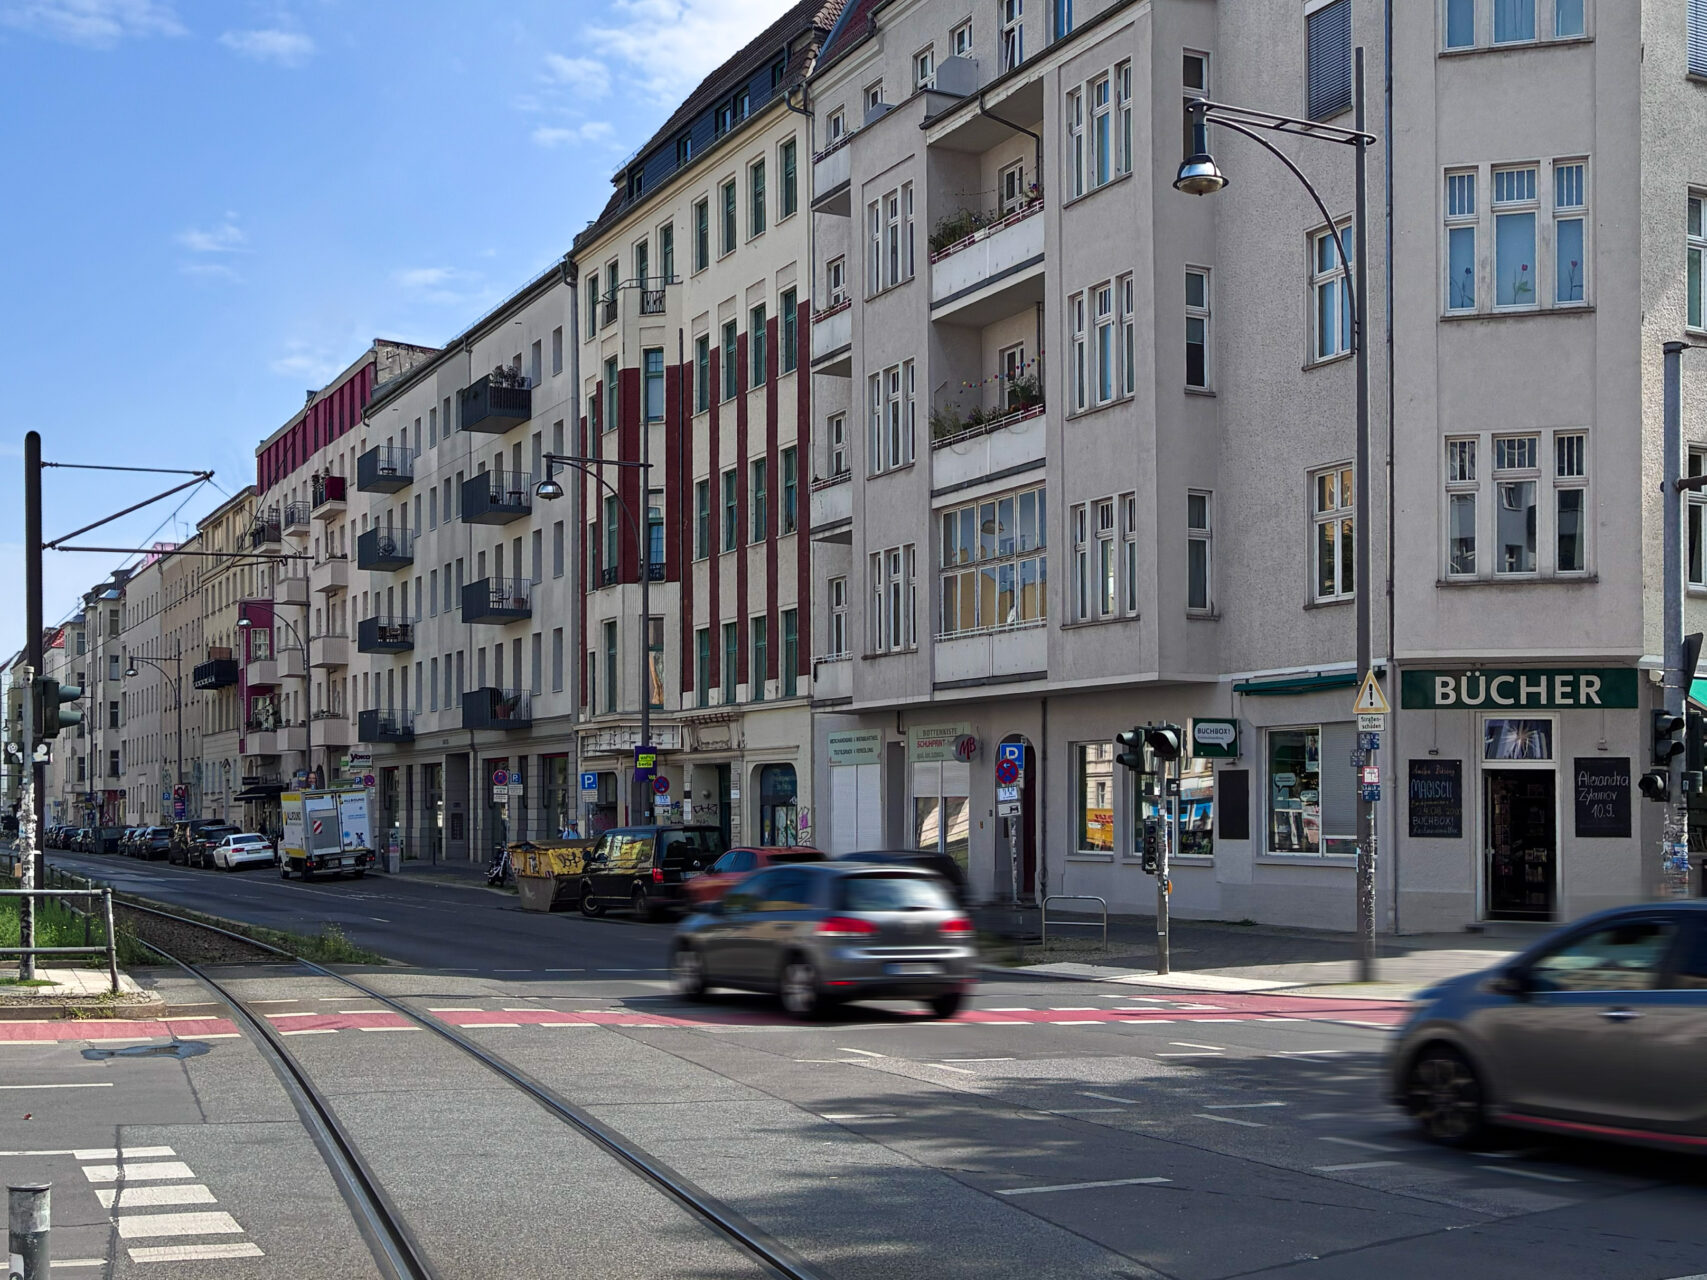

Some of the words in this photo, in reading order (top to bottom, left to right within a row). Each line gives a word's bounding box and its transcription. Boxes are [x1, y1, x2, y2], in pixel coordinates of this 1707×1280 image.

[1434, 671, 1602, 705] BÜCHER
[584, 775, 593, 788] P
[1578, 770, 1629, 786] Alexandra
[1591, 803, 1615, 818] 10.9.
